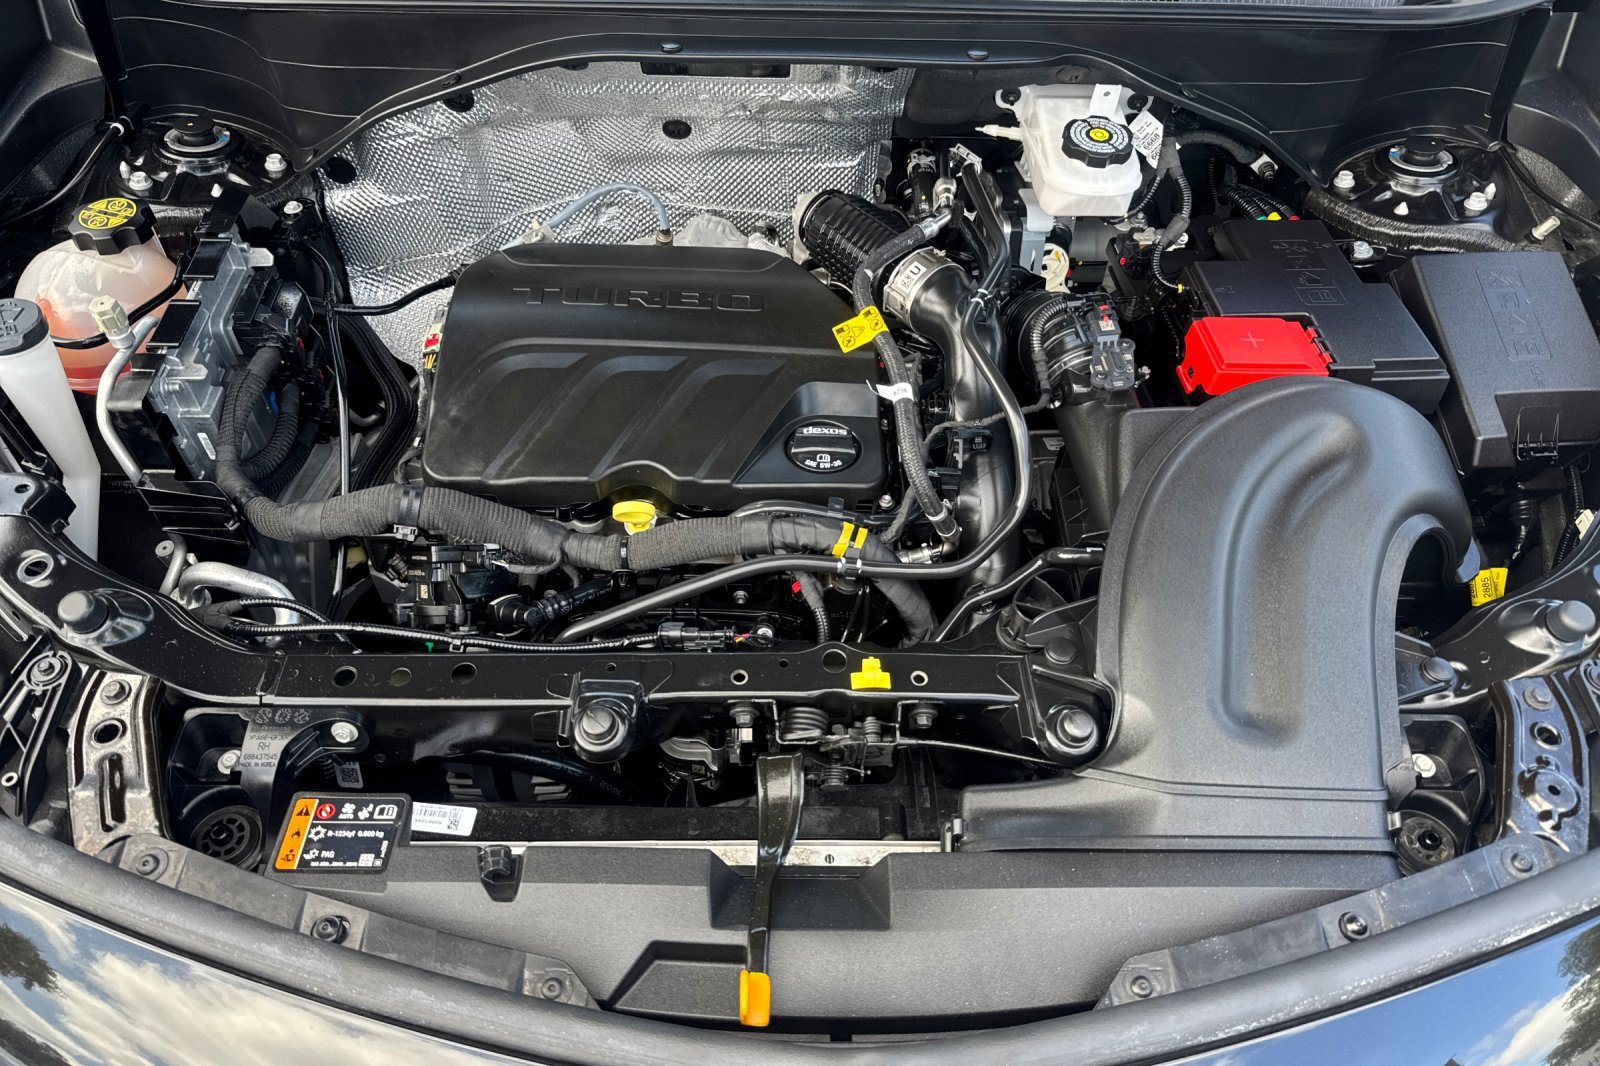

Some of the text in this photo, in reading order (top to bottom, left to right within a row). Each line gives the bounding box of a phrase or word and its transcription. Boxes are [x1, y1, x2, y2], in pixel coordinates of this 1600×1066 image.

[512, 287, 765, 312] TURBO
[803, 426, 848, 436] dexos
[804, 459, 818, 468] SAE
[1481, 577, 1492, 598] 2885
[257, 742, 271, 751] RH
[327, 830, 356, 839] R-1234yf
[321, 850, 335, 858] PAG
